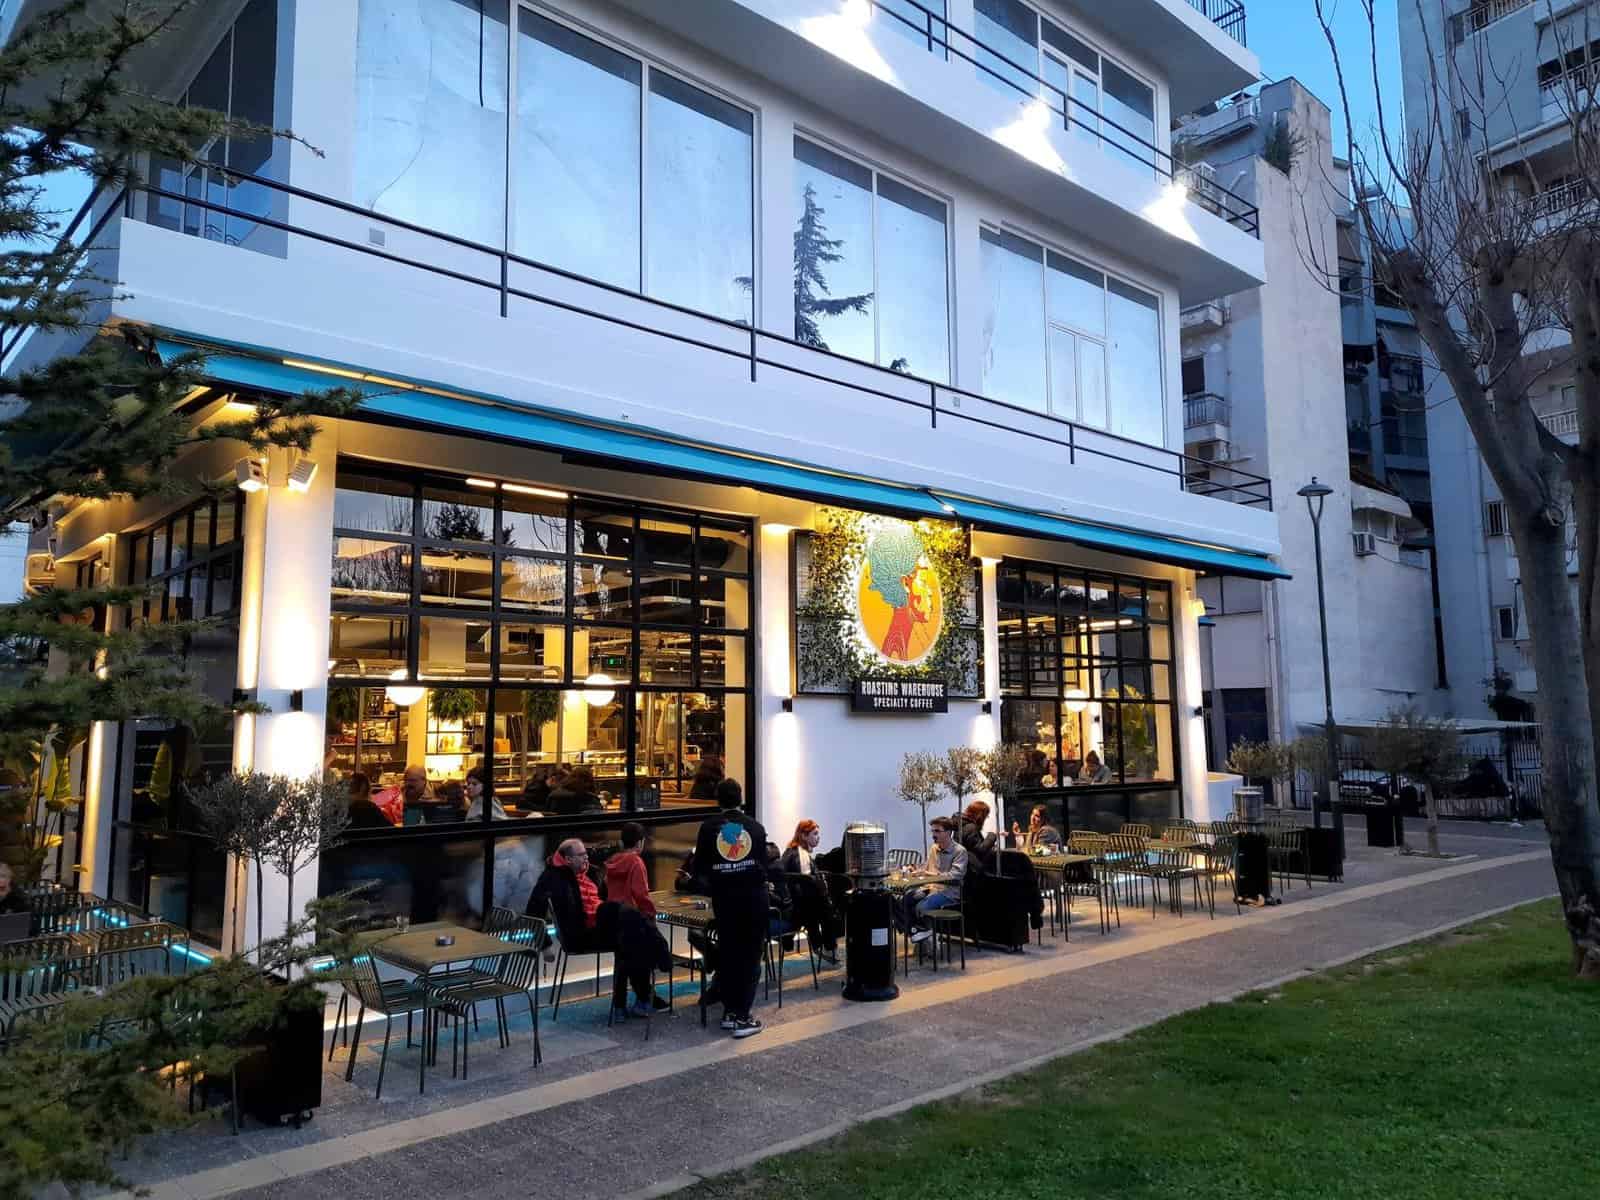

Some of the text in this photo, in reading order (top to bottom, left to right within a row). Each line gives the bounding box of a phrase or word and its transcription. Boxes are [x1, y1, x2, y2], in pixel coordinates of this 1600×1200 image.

[861, 681, 944, 697] ROASTING WAREHOUSE
[873, 697, 934, 709] SPECIALTY COFFEE
